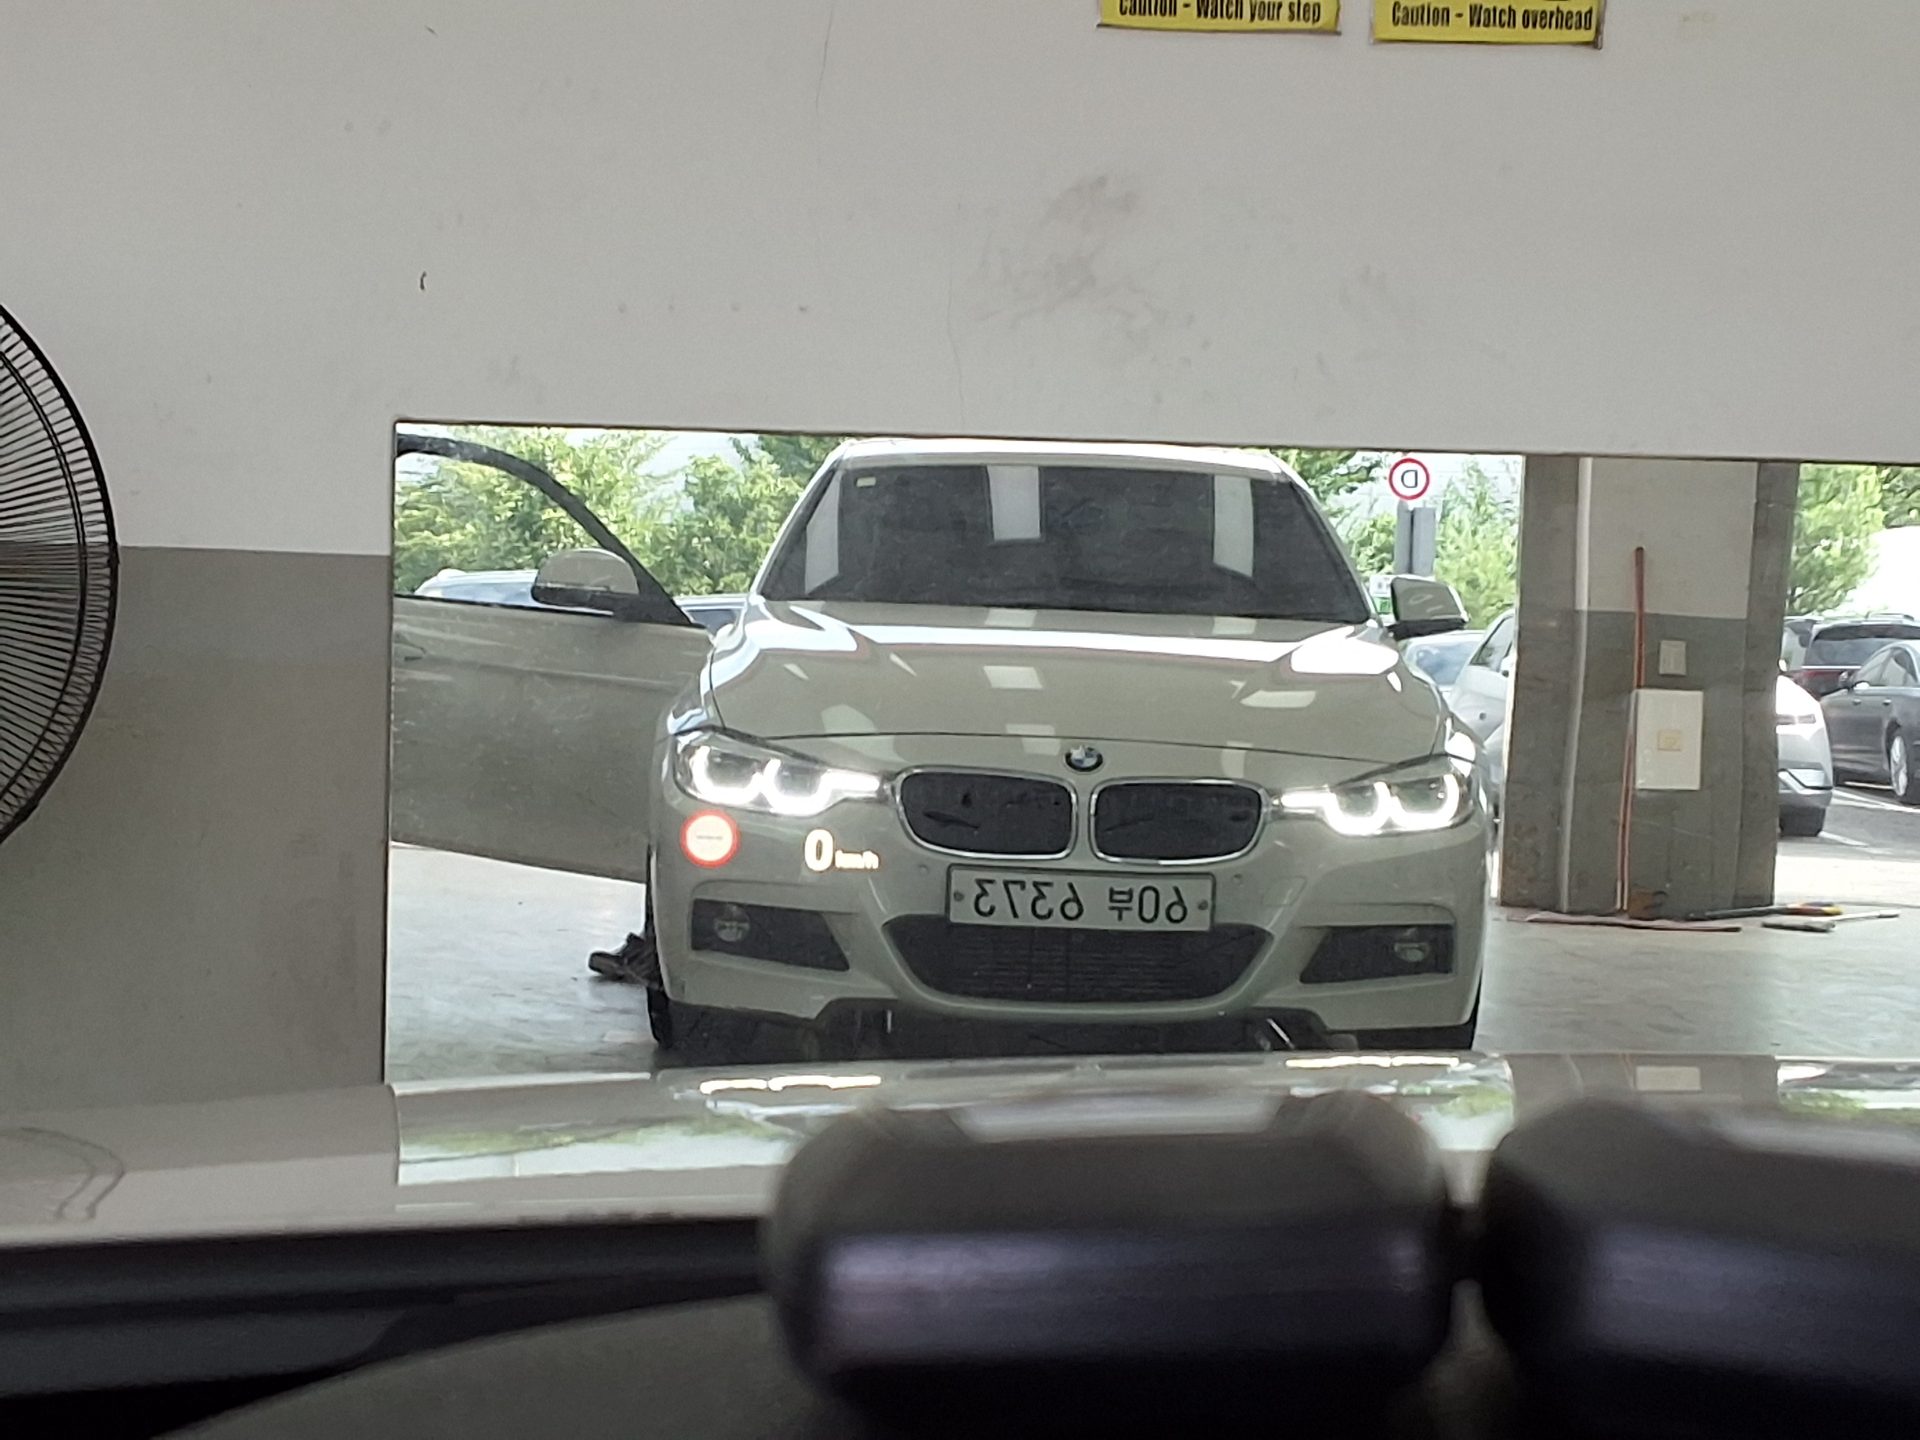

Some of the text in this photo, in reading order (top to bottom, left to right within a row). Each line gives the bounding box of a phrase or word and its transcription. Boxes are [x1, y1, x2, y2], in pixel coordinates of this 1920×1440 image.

[1196, 0, 1243, 20] Watch
[1249, 1, 1282, 23] your
[1288, 1, 1321, 24] step
[1392, 1, 1450, 27] Caution
[1469, 3, 1516, 29] Watch
[1522, 6, 1593, 31] overhead
[804, 829, 833, 872] 0
